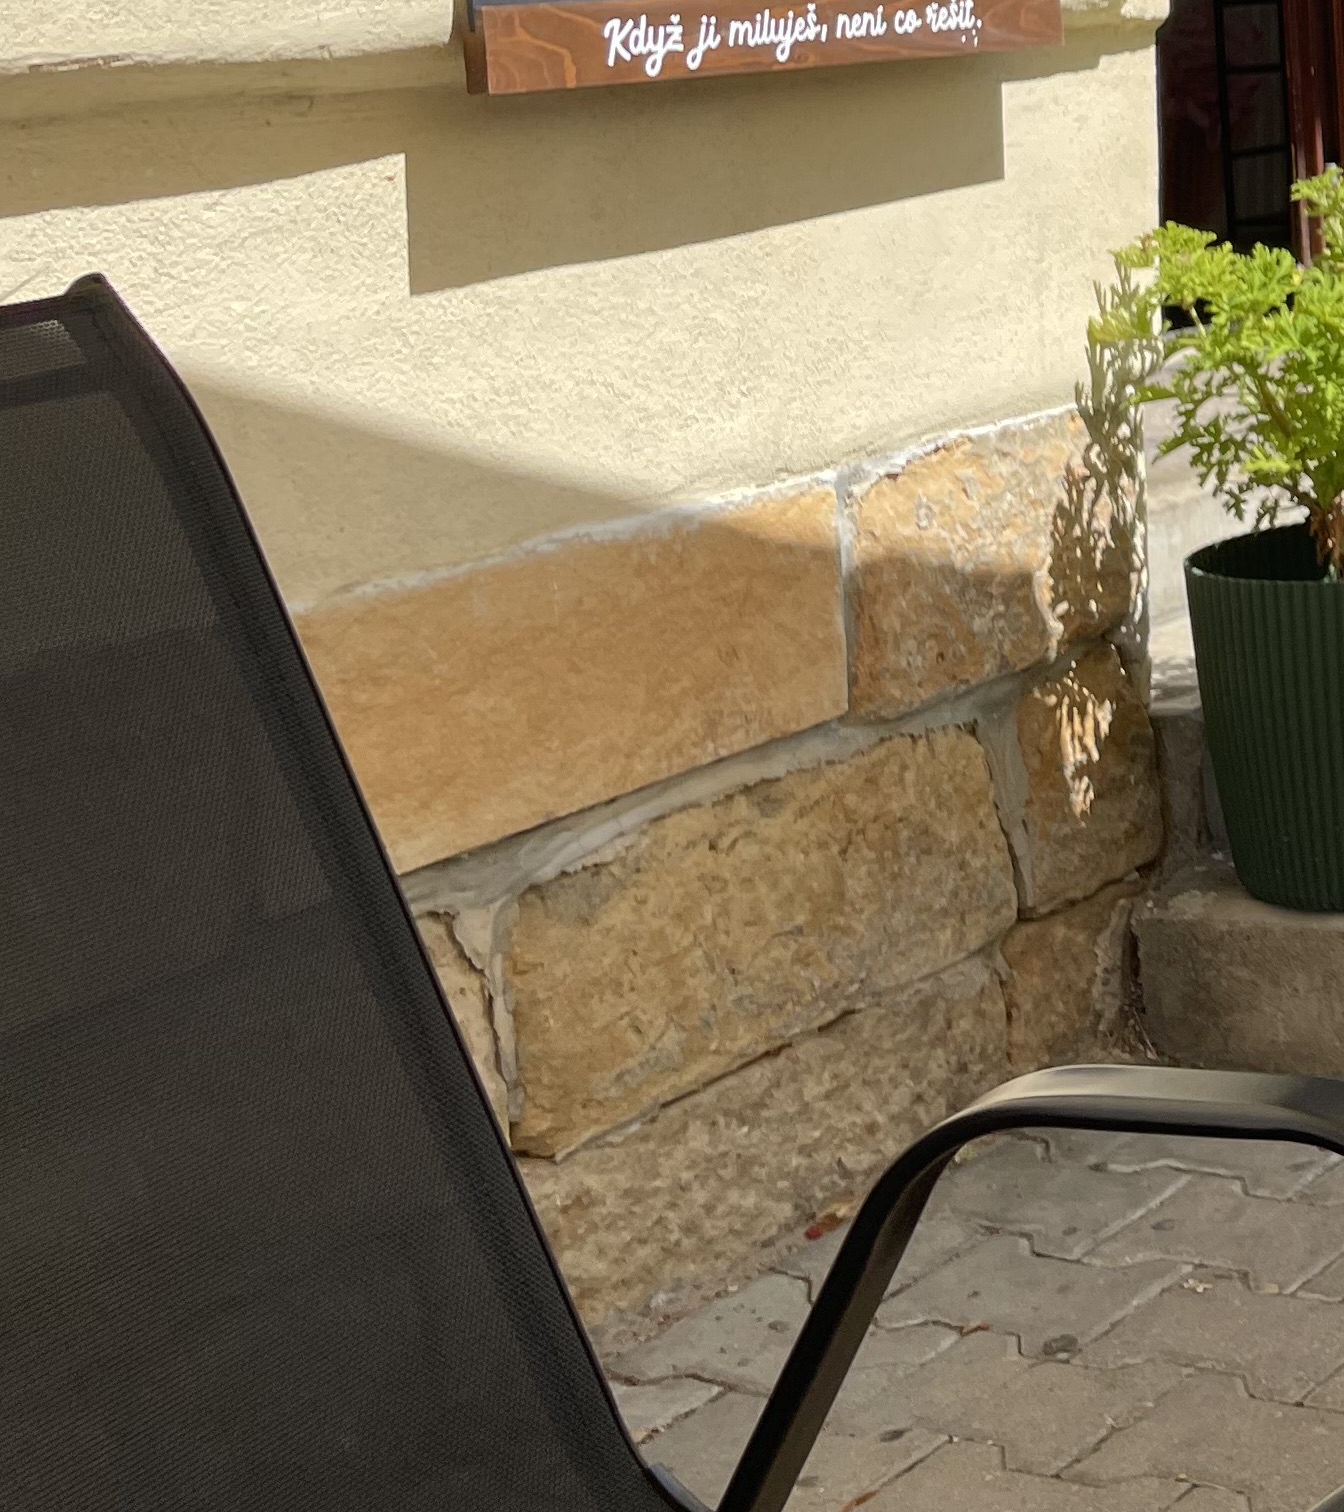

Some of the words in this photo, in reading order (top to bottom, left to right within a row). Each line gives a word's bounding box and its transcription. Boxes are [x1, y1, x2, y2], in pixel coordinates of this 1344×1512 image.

[603, 12, 685, 78] Když
[686, 13, 722, 71] ji
[727, 2, 829, 64] miluješ,
[835, 4, 887, 40] není
[893, 10, 923, 35] co
